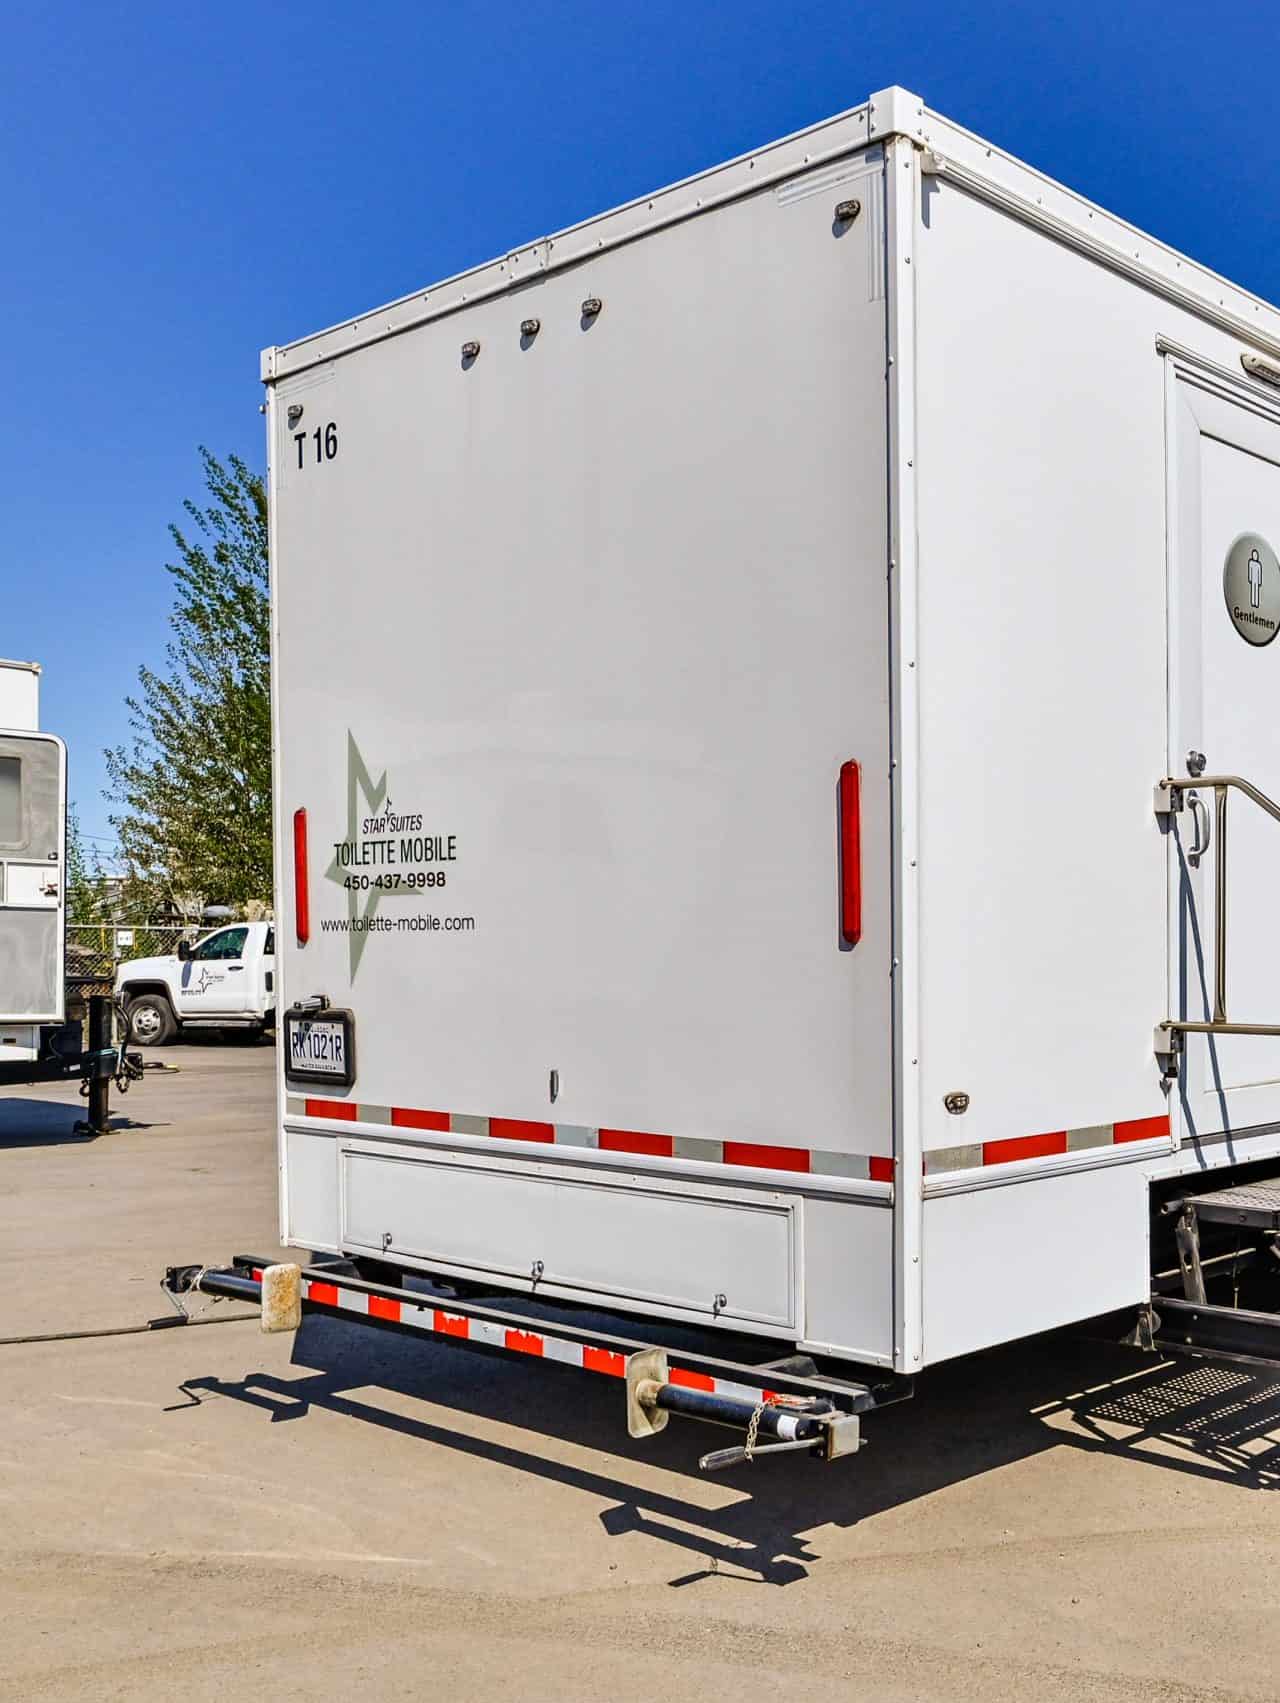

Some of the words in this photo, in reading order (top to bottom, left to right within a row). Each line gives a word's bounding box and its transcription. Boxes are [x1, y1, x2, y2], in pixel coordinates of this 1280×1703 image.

[293, 431, 307, 470] T
[312, 421, 338, 464] 16
[1232, 605, 1276, 630] Gentlemen
[362, 817, 386, 834] STAR
[389, 814, 423, 833] SUITES
[333, 840, 397, 868] TOILETTE
[400, 835, 457, 863] MOBILE
[343, 871, 447, 891] 450-437-9998
[320, 913, 476, 932] www.toilette-mobile.com
